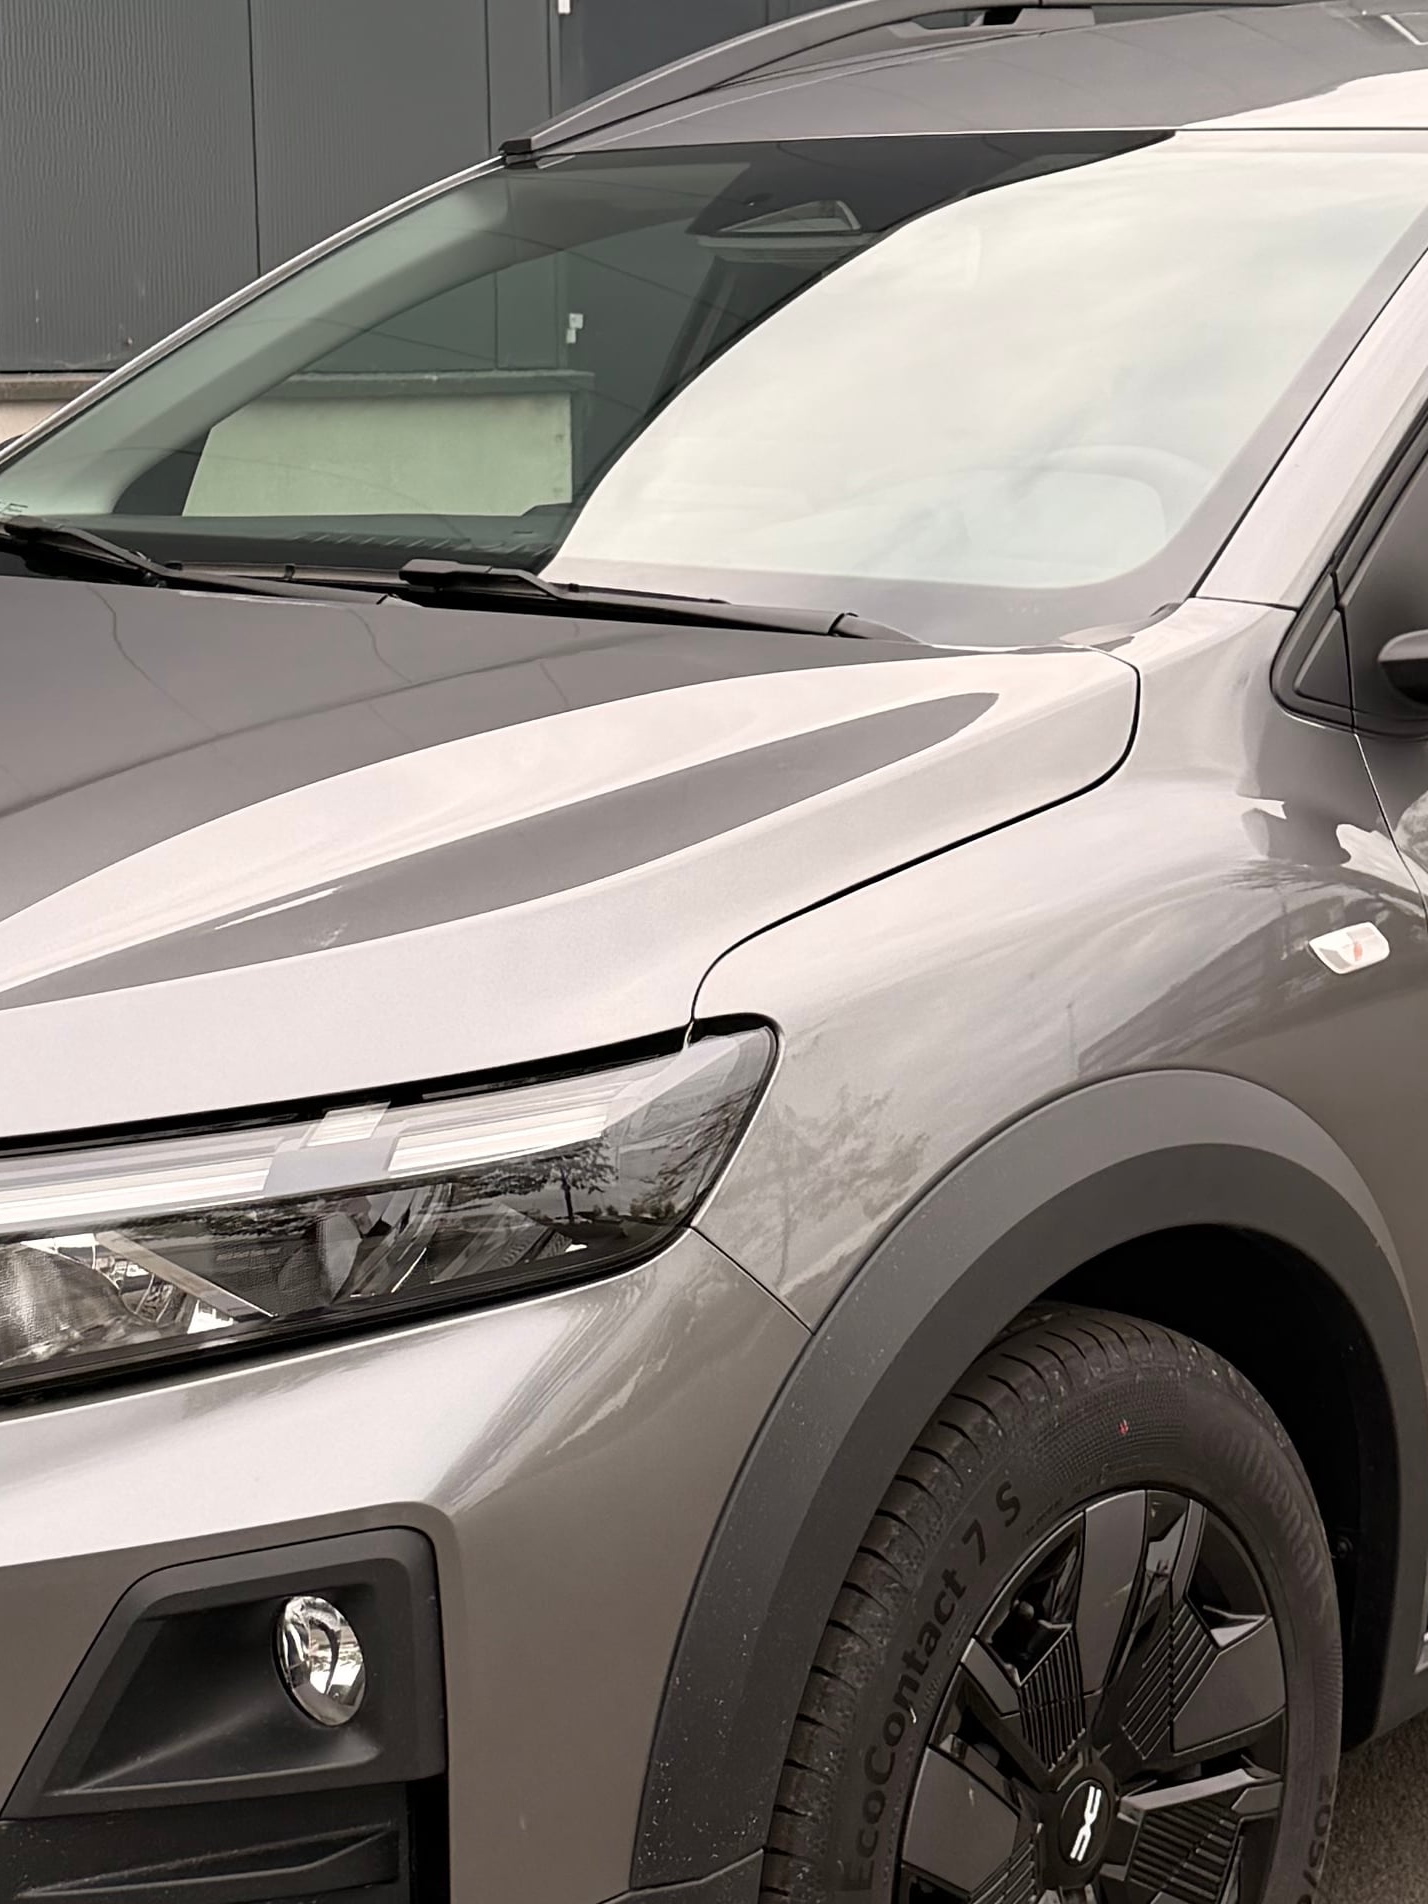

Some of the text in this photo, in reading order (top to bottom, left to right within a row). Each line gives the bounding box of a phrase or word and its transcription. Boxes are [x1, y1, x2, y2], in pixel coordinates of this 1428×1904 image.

[842, 1481, 1021, 1892] EcoContact 7 S
